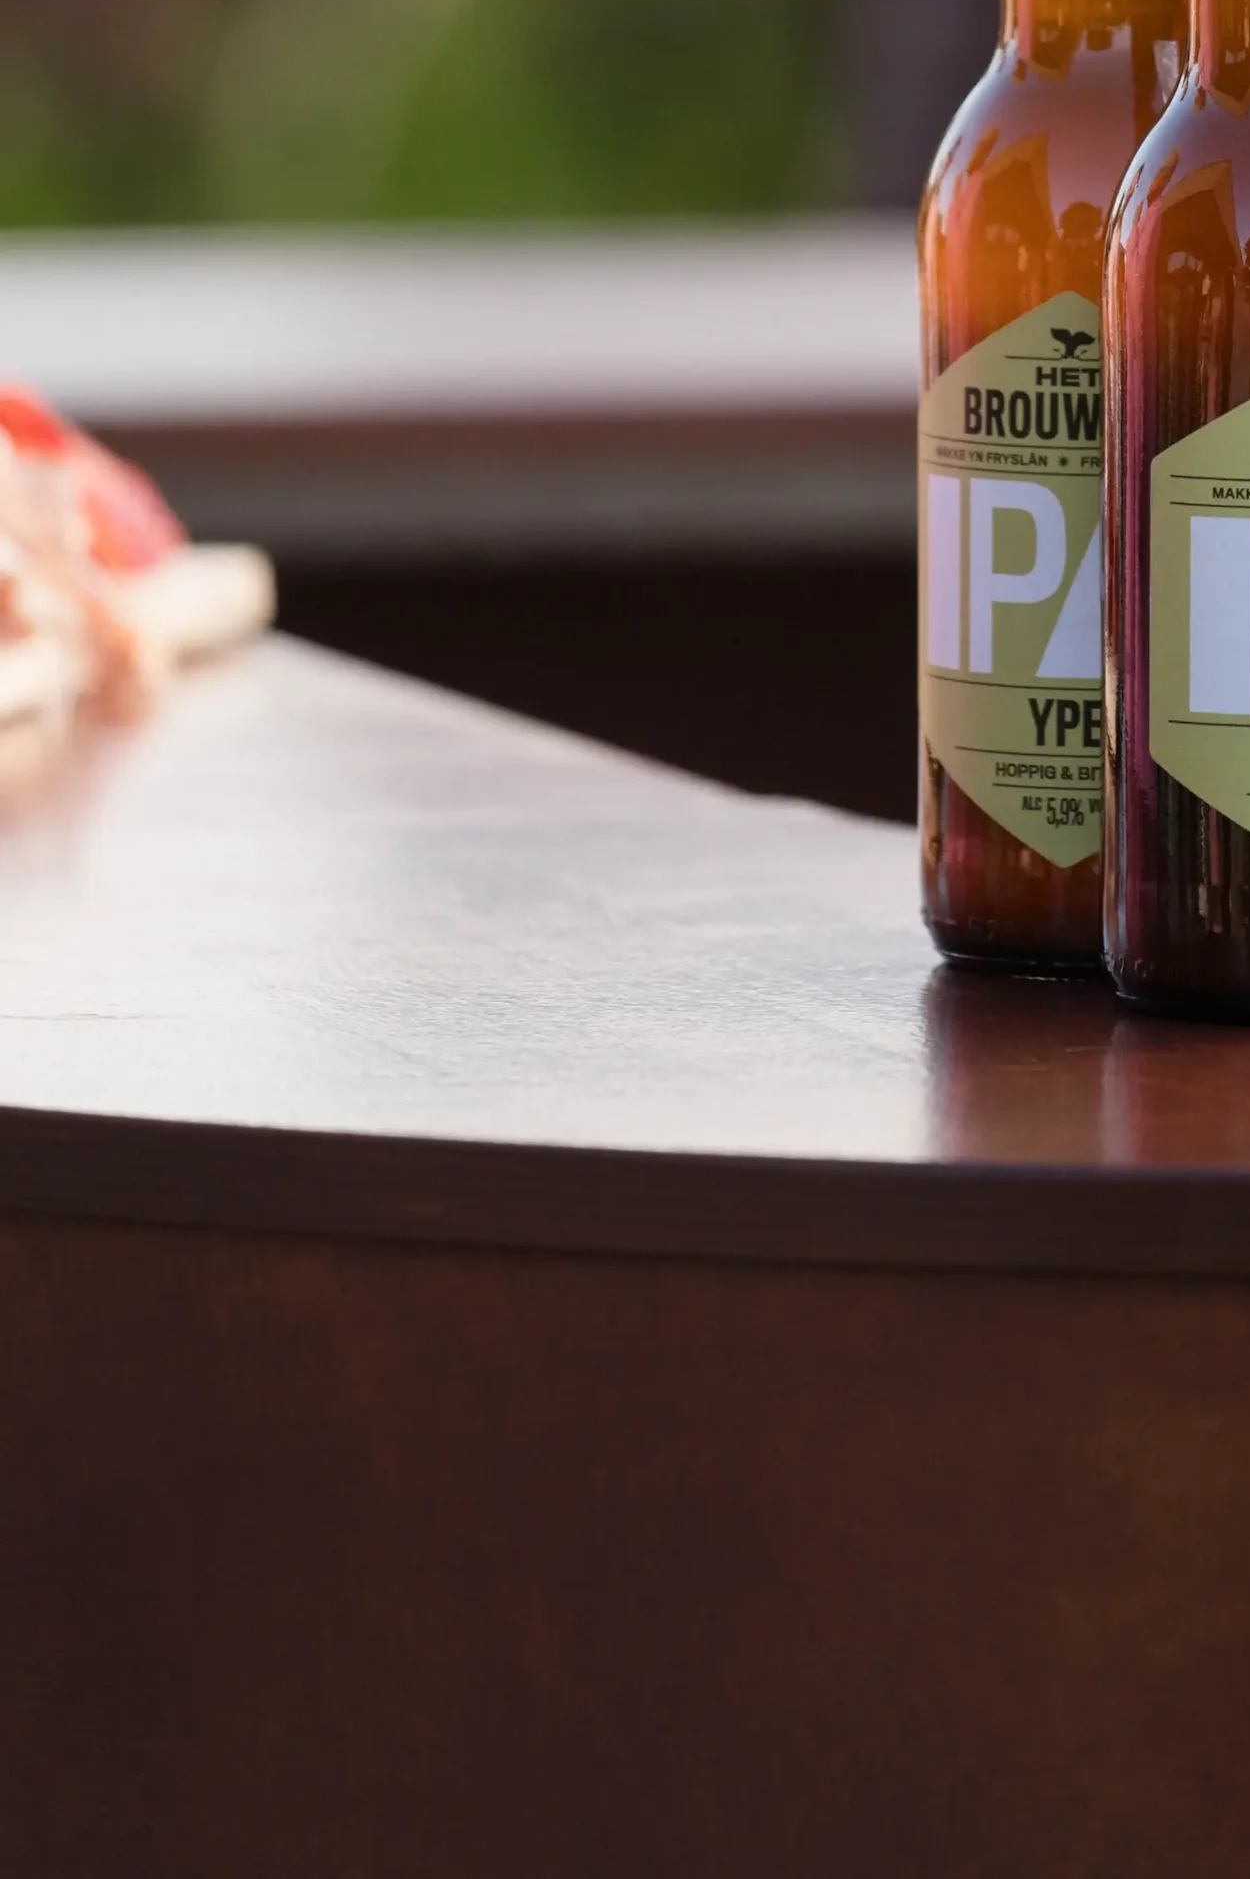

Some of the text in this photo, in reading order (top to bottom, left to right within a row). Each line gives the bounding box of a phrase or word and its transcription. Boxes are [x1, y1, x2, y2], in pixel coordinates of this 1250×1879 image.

[1035, 366, 1101, 387] HET
[963, 386, 1101, 441] BROUW
[968, 450, 984, 463] YN
[1027, 698, 1101, 748] YPE
[995, 762, 1057, 780] HOPPIG
[1060, 766, 1074, 781] &
[1021, 795, 1043, 811] ALC
[1046, 797, 1085, 828] 5,9%
